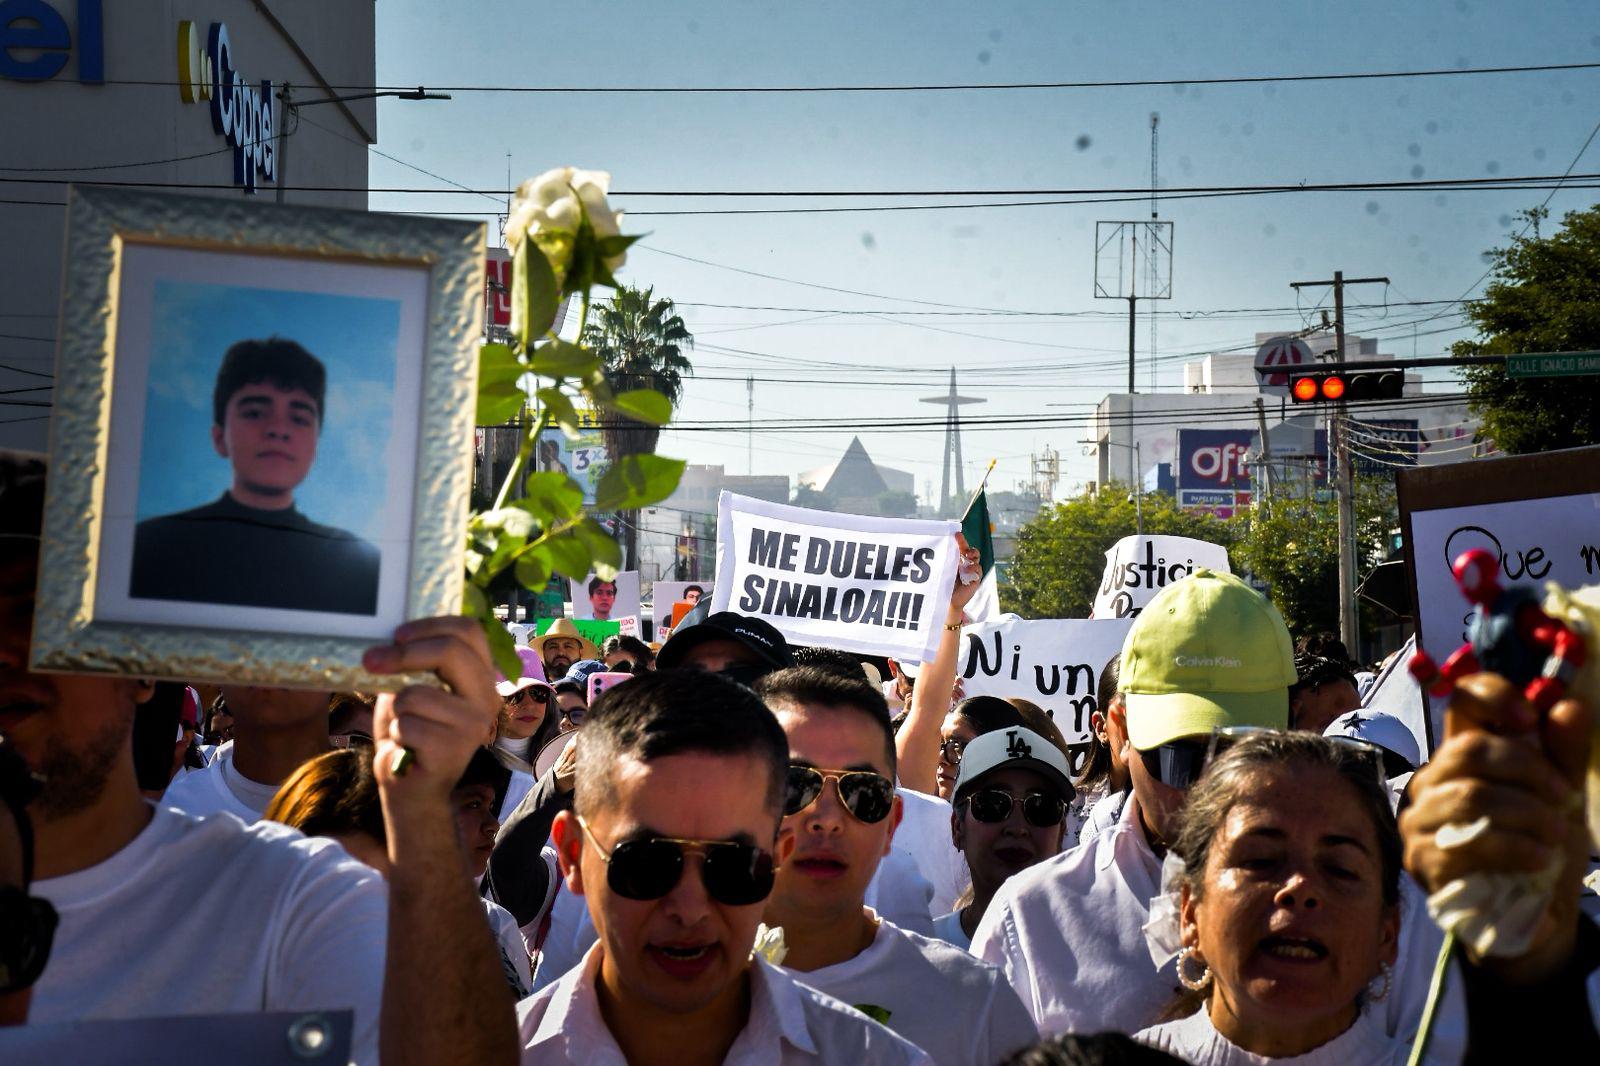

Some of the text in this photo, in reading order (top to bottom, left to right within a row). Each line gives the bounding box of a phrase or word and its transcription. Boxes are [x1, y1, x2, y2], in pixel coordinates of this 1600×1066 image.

[208, 22, 275, 194] Coppel
[1509, 359, 1537, 373] CALLE
[1541, 358, 1575, 371] IGNACIO
[748, 528, 935, 583] ME DUELES
[1103, 541, 1198, 595] Justici
[739, 574, 925, 631] SINALOA!!!
[963, 631, 1021, 680] Ni
[1175, 655, 1242, 668] Calvin Klein
[1006, 731, 1032, 758] LA
